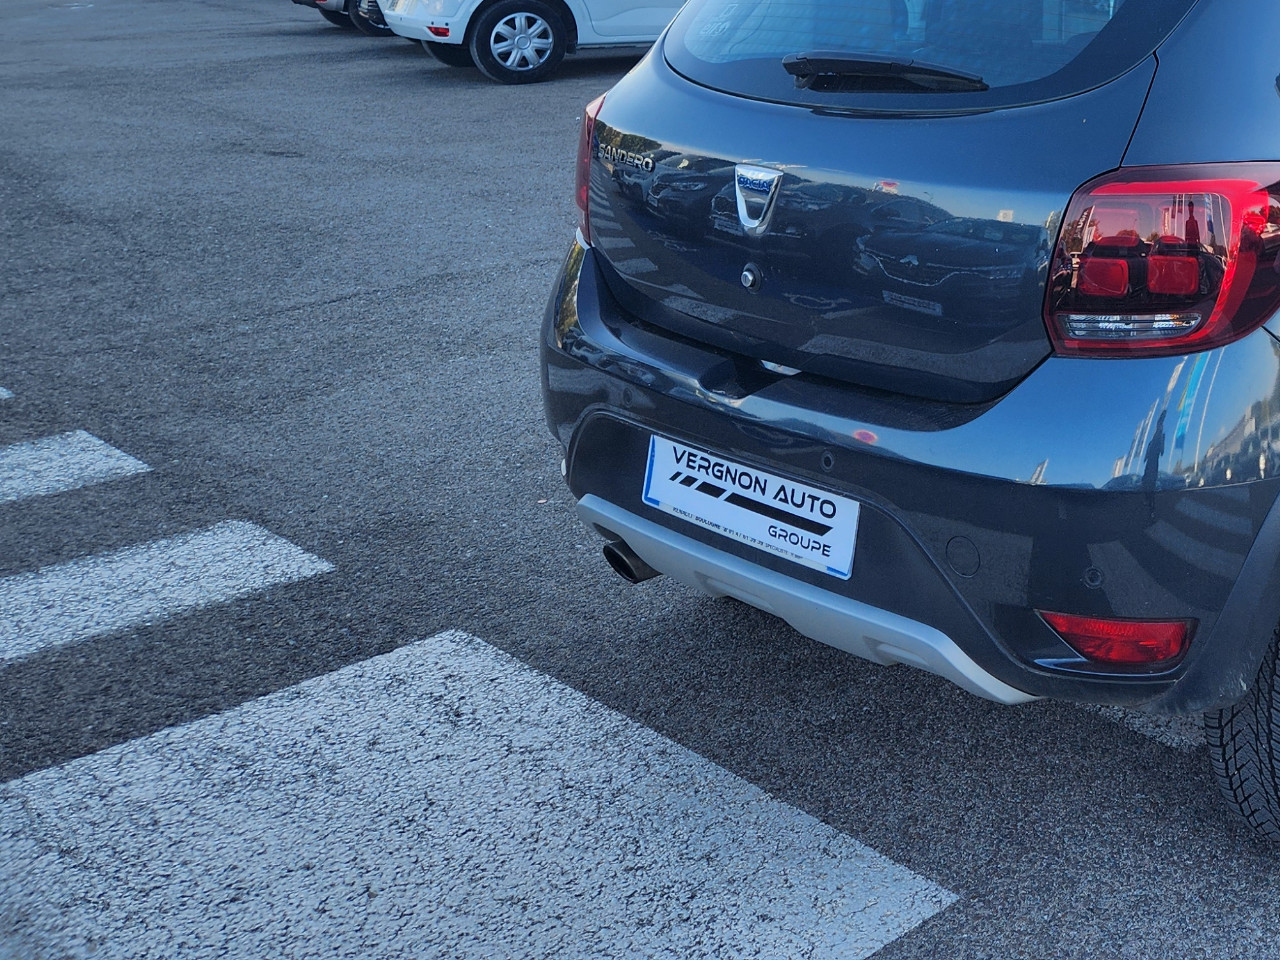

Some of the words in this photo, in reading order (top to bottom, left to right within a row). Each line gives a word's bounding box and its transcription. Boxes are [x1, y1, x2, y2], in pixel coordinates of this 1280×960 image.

[597, 143, 657, 174] SANDERO
[738, 176, 770, 192] DACIA
[672, 445, 768, 497] VERGNON
[772, 484, 837, 520] AUTO
[767, 524, 833, 558] GROUPE
